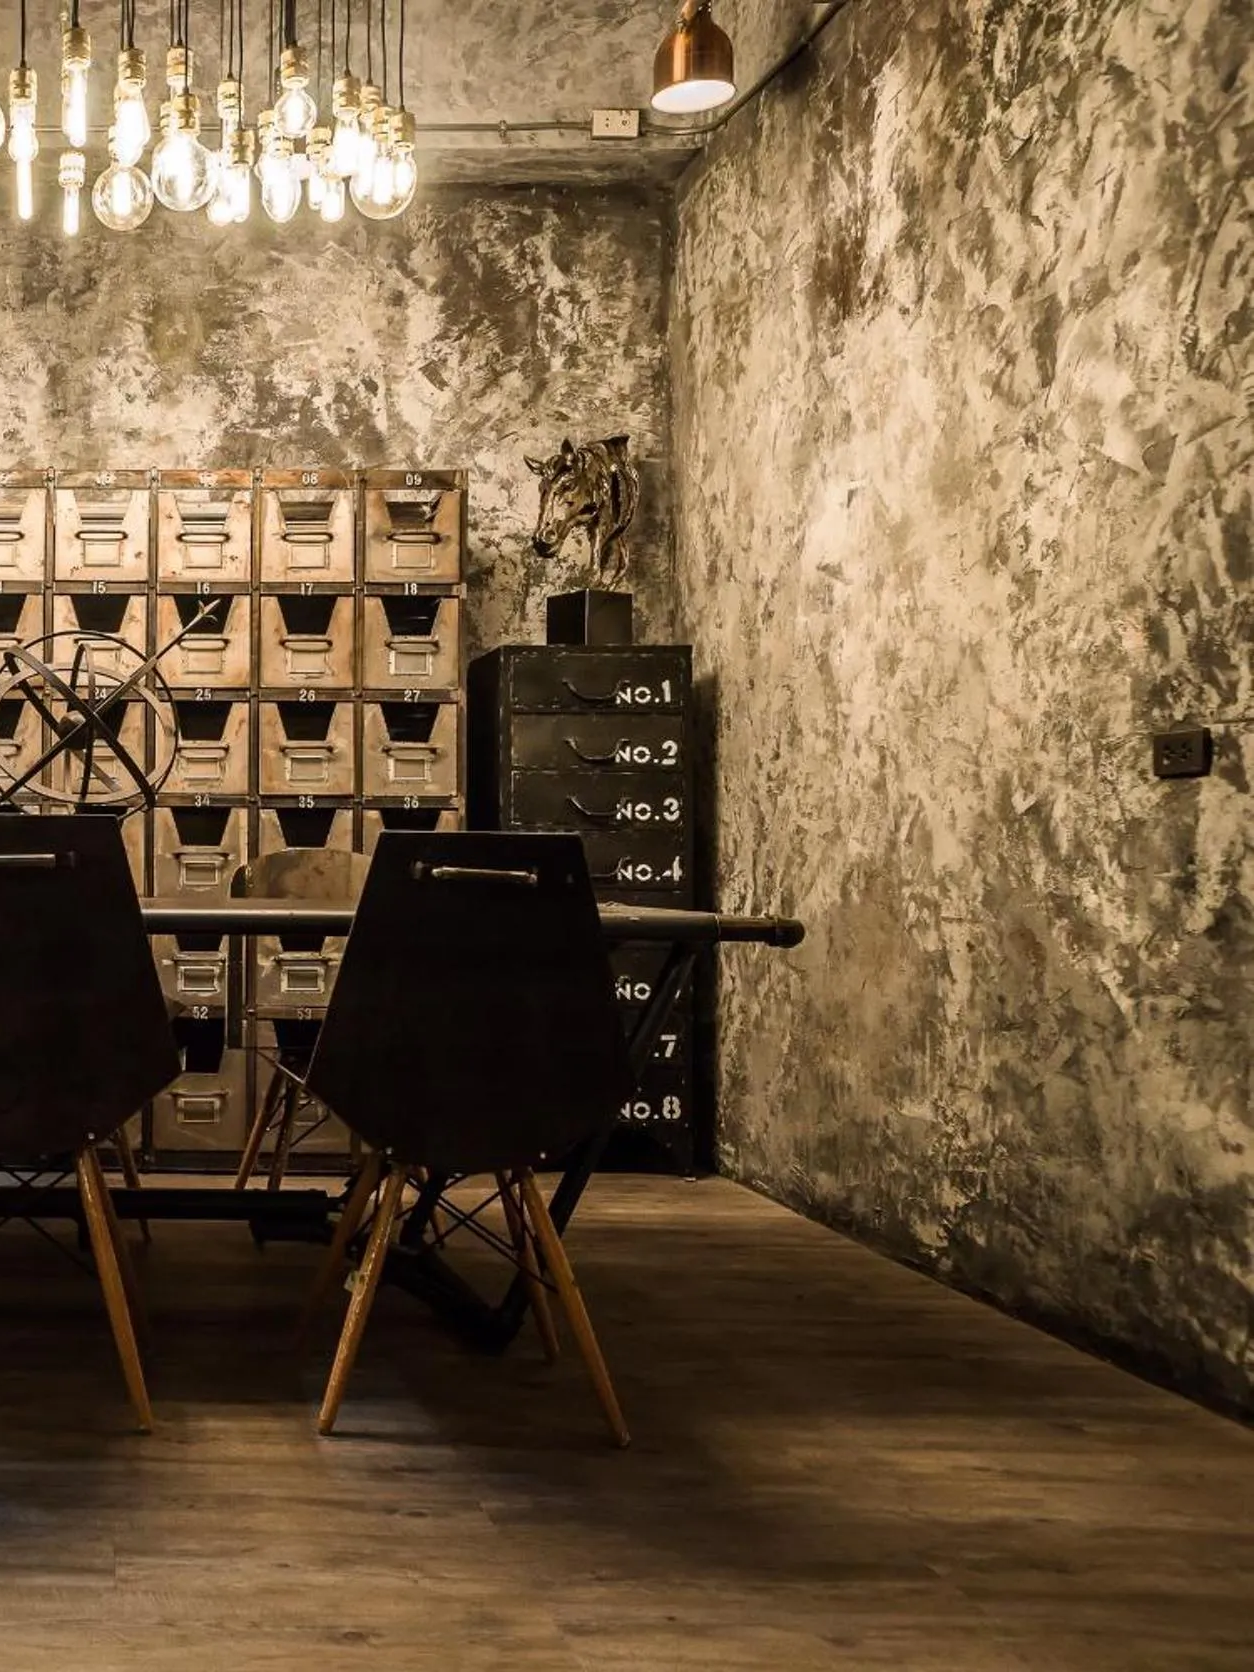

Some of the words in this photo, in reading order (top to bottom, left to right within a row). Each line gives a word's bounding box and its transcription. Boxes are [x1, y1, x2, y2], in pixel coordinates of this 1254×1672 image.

[302, 473, 318, 485] 08
[405, 473, 422, 485] 09
[92, 581, 107, 593] 15
[196, 582, 210, 594] 16
[300, 583, 314, 595] 17
[403, 583, 418, 595] 18
[95, 687, 106, 699] 24
[195, 688, 211, 700] 25
[299, 689, 315, 701] 26
[404, 690, 421, 702] 27
[616, 680, 672, 705] NO.1
[615, 740, 679, 765] NO.2
[195, 795, 210, 807] 34
[299, 796, 314, 808] 35
[404, 796, 419, 809] 36
[616, 797, 680, 821] NO.3
[617, 856, 682, 882] NO.4
[193, 1006, 208, 1019] 52
[620, 1095, 682, 1119] NO.8
